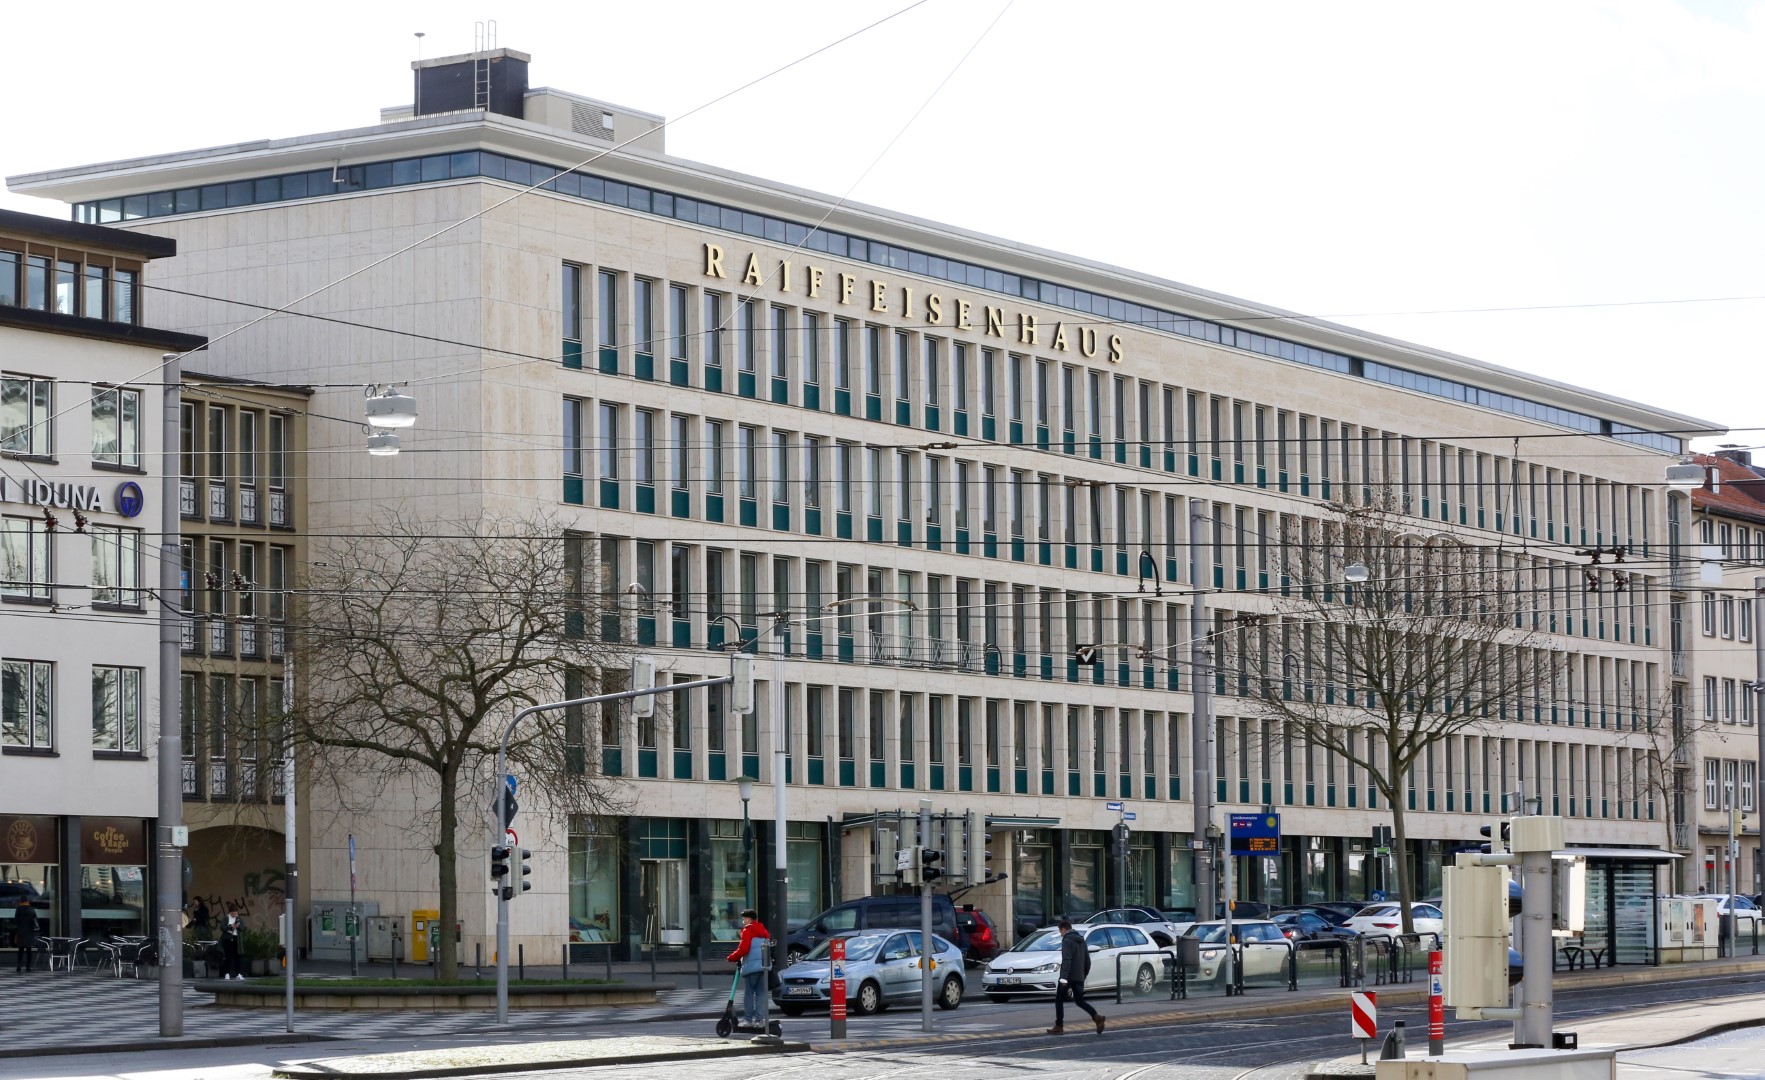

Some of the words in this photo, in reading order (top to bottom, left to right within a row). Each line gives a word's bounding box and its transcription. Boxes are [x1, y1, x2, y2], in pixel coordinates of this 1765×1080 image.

[704, 243, 1124, 364] RAIFFEISENHAUS
[0, 476, 21, 503] L
[26, 479, 106, 512] IDUNA
[93, 831, 125, 841] Coffee
[107, 840, 129, 849] Bagel
